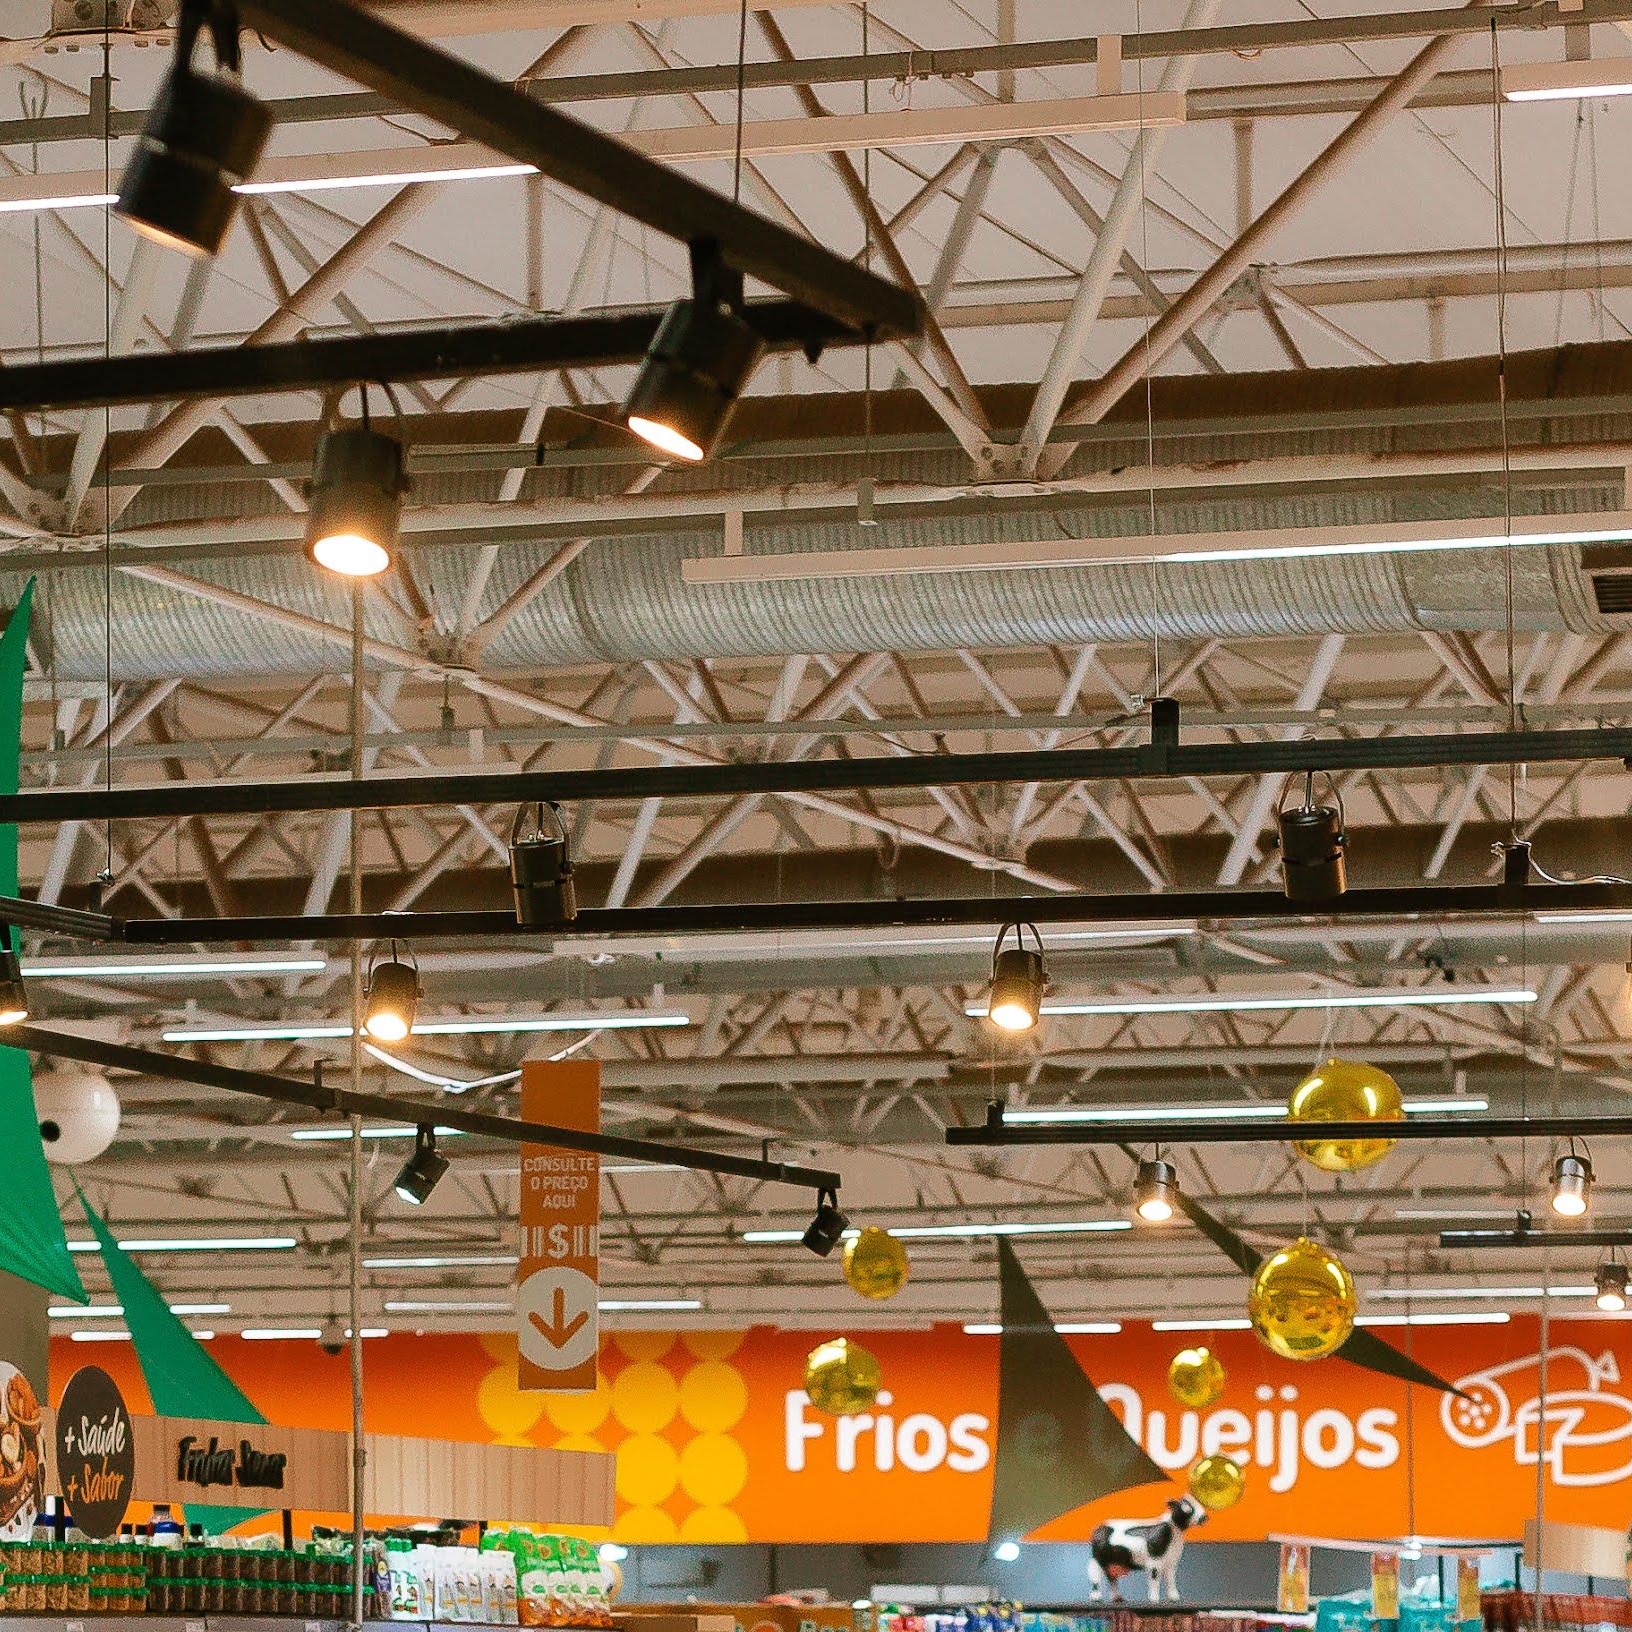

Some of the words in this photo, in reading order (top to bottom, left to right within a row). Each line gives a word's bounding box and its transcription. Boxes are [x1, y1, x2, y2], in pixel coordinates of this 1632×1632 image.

[524, 1157, 596, 1172] CONSULTE
[531, 1176, 540, 1191] O
[543, 1176, 589, 1193] PREÇO
[542, 1194, 576, 1210] AQUI
[78, 1406, 125, 1457] Saúde
[785, 1389, 991, 1473] Frios
[81, 1456, 124, 1503] Sabor
